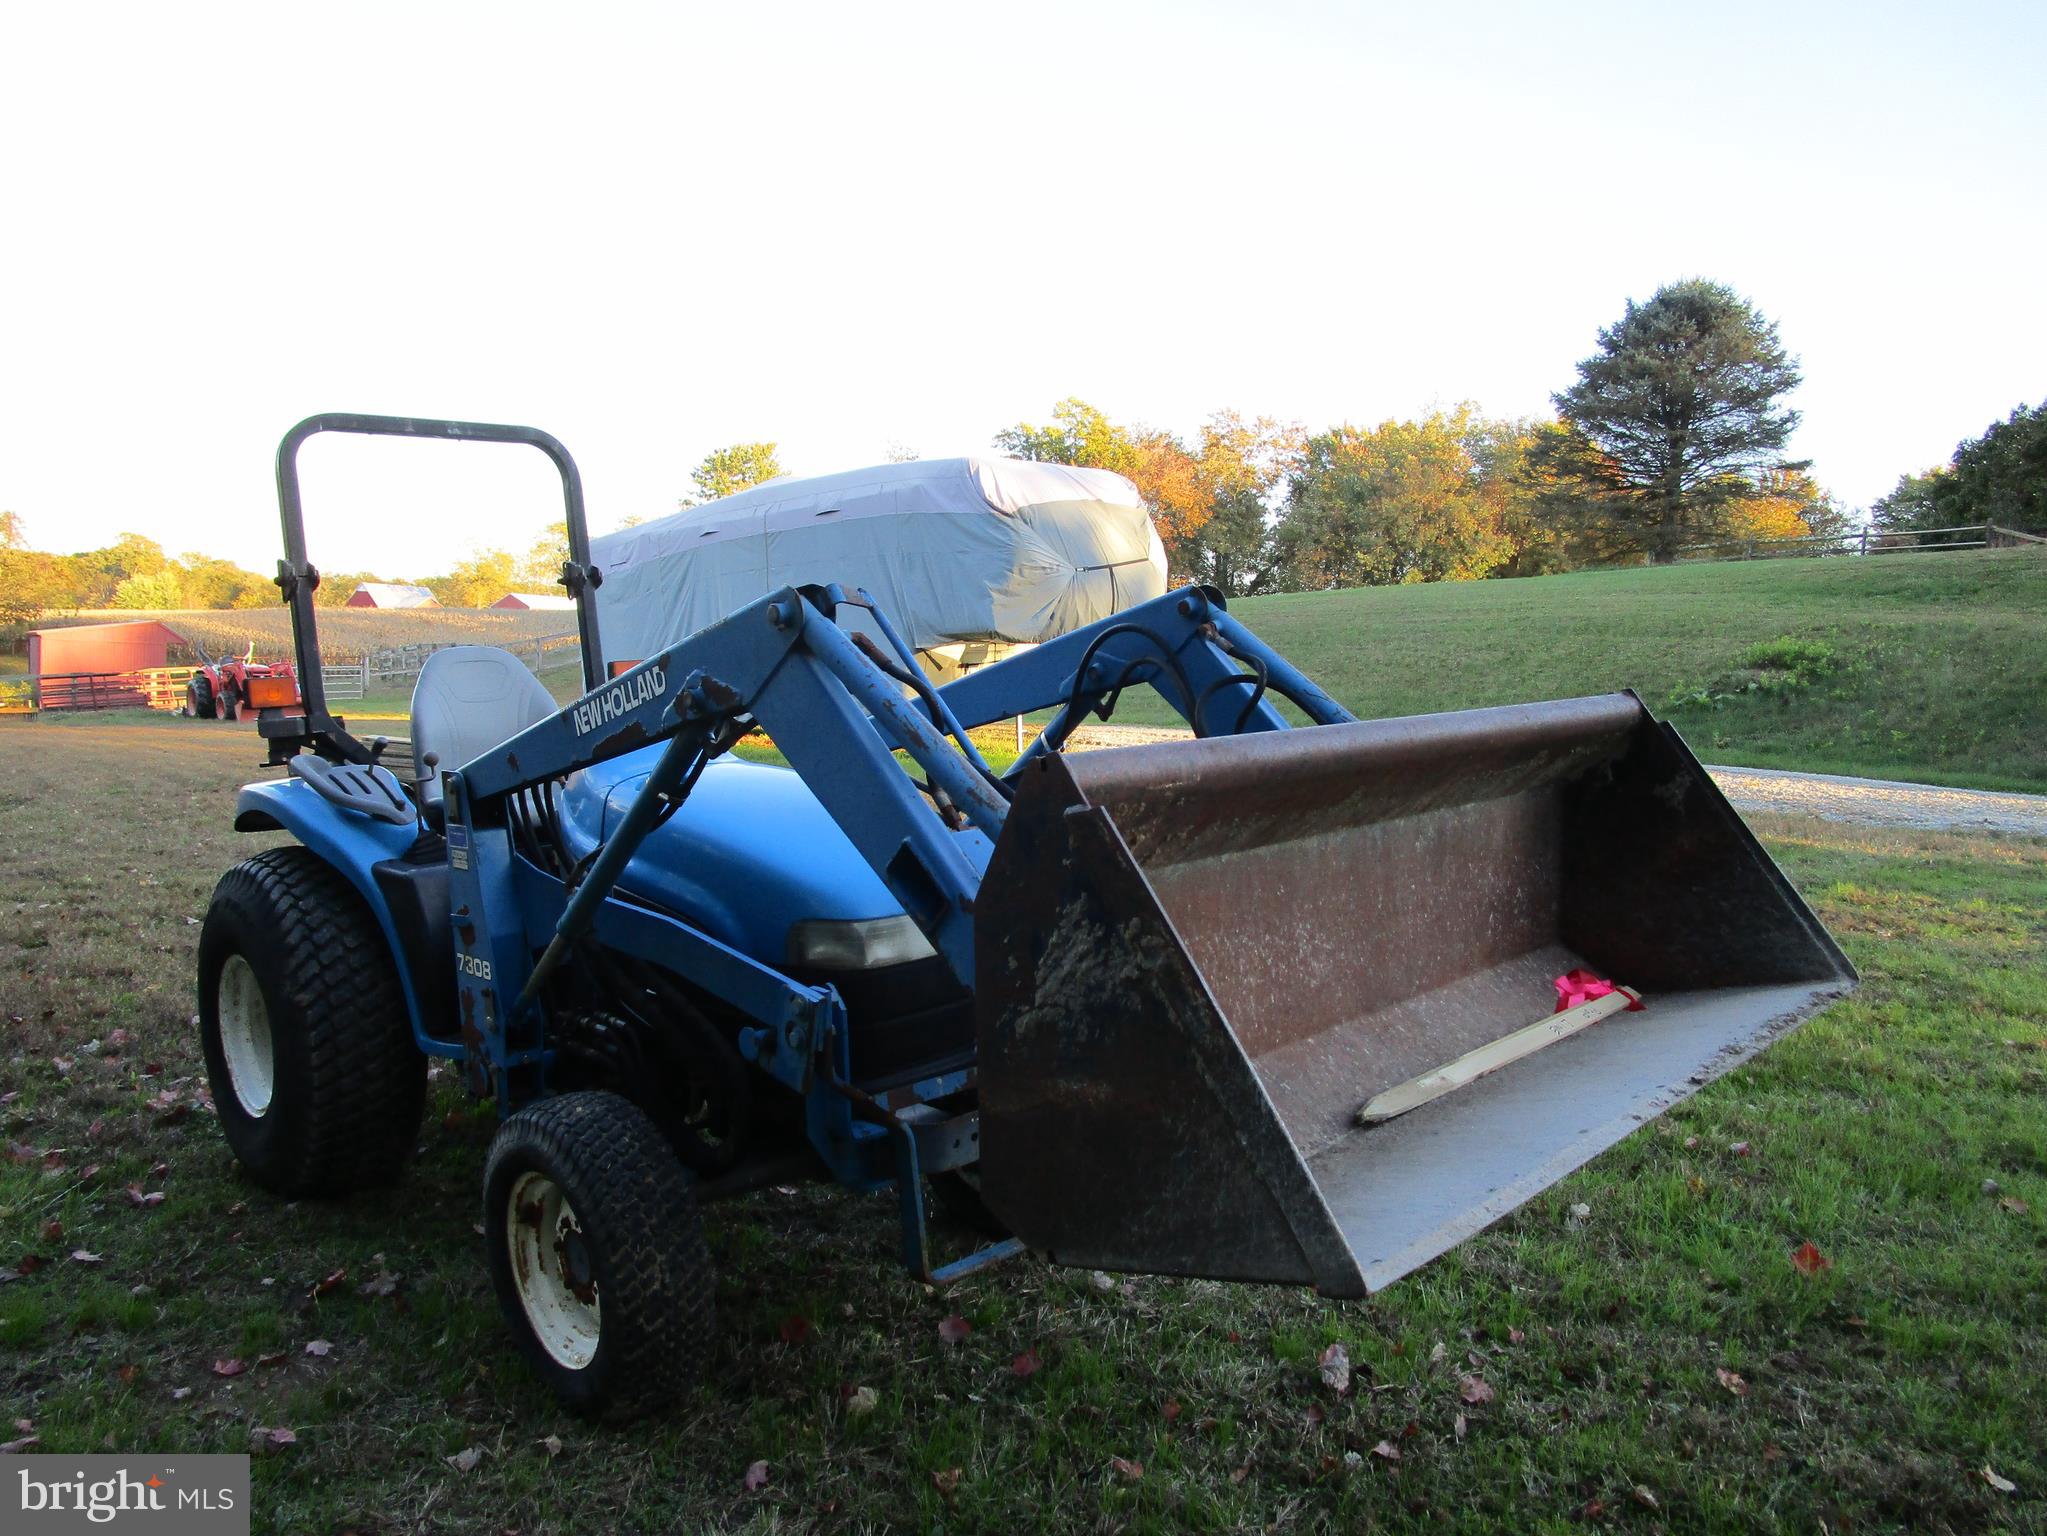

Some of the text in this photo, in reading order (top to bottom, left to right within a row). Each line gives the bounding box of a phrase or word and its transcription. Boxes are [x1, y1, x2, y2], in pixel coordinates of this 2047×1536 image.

[573, 665, 666, 737] NEW HOLLAND
[456, 952, 492, 981] 7308
